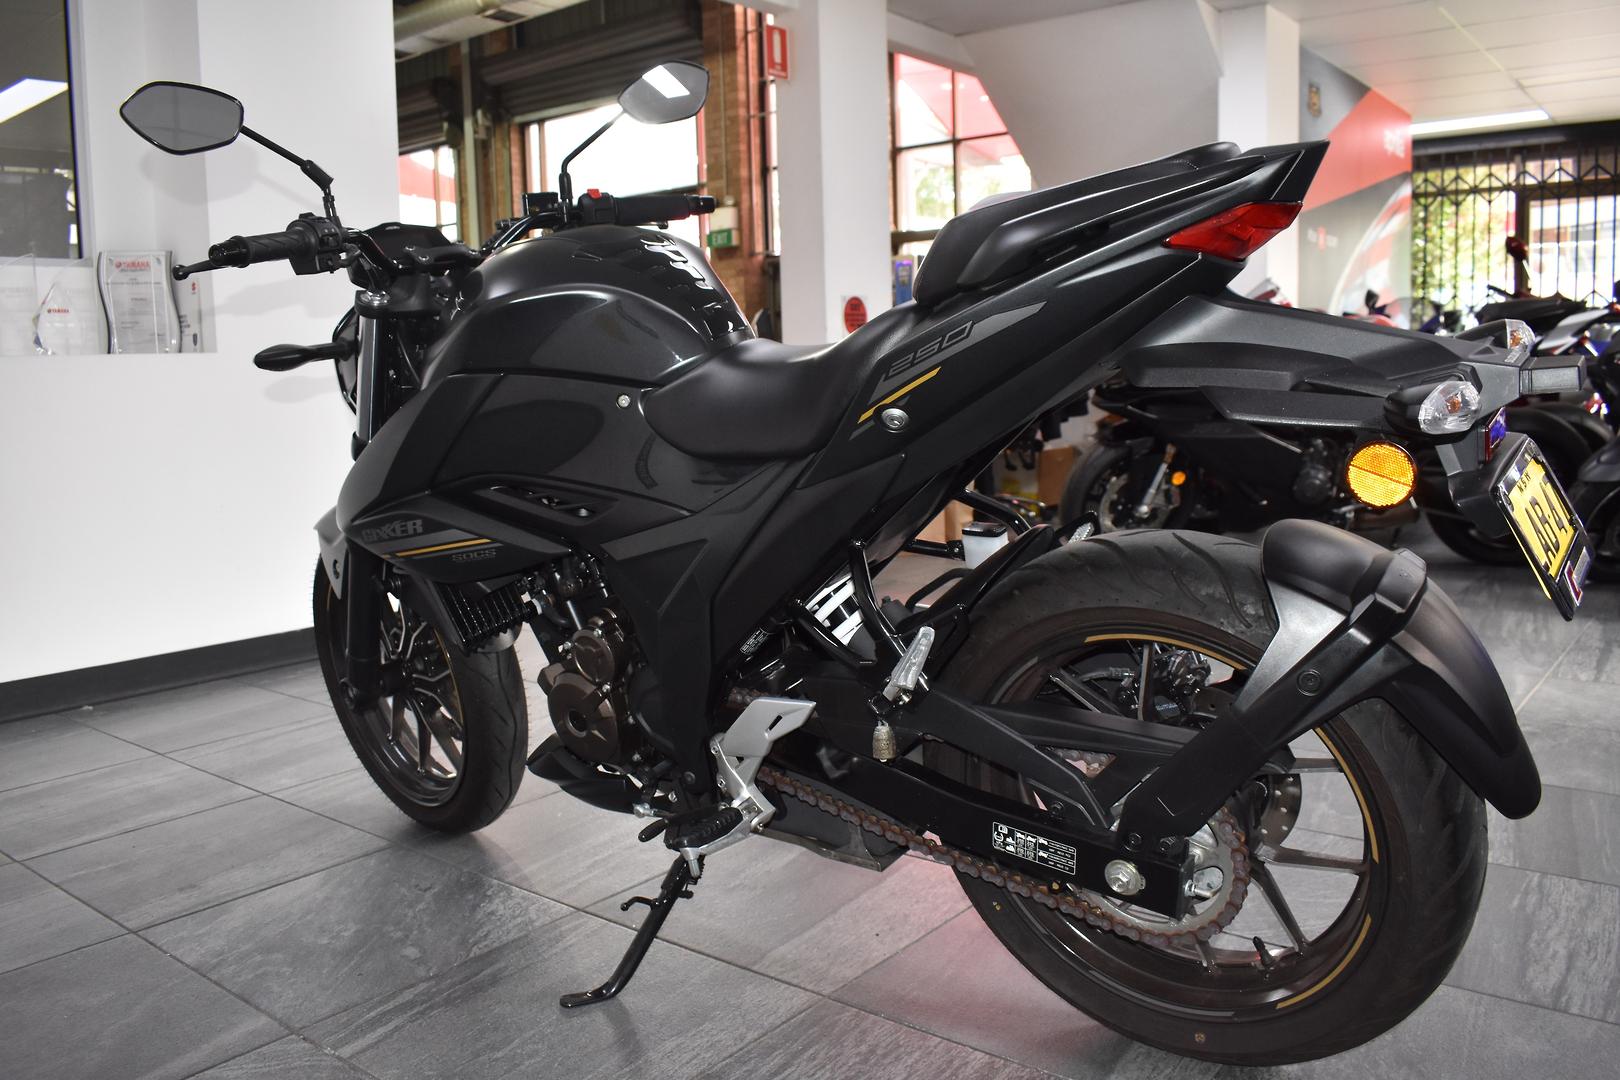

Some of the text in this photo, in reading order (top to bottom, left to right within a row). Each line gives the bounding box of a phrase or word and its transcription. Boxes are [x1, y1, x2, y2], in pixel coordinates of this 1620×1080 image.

[711, 232, 729, 246] EXIT
[122, 260, 151, 269] YAMAHA
[883, 320, 975, 382] 250
